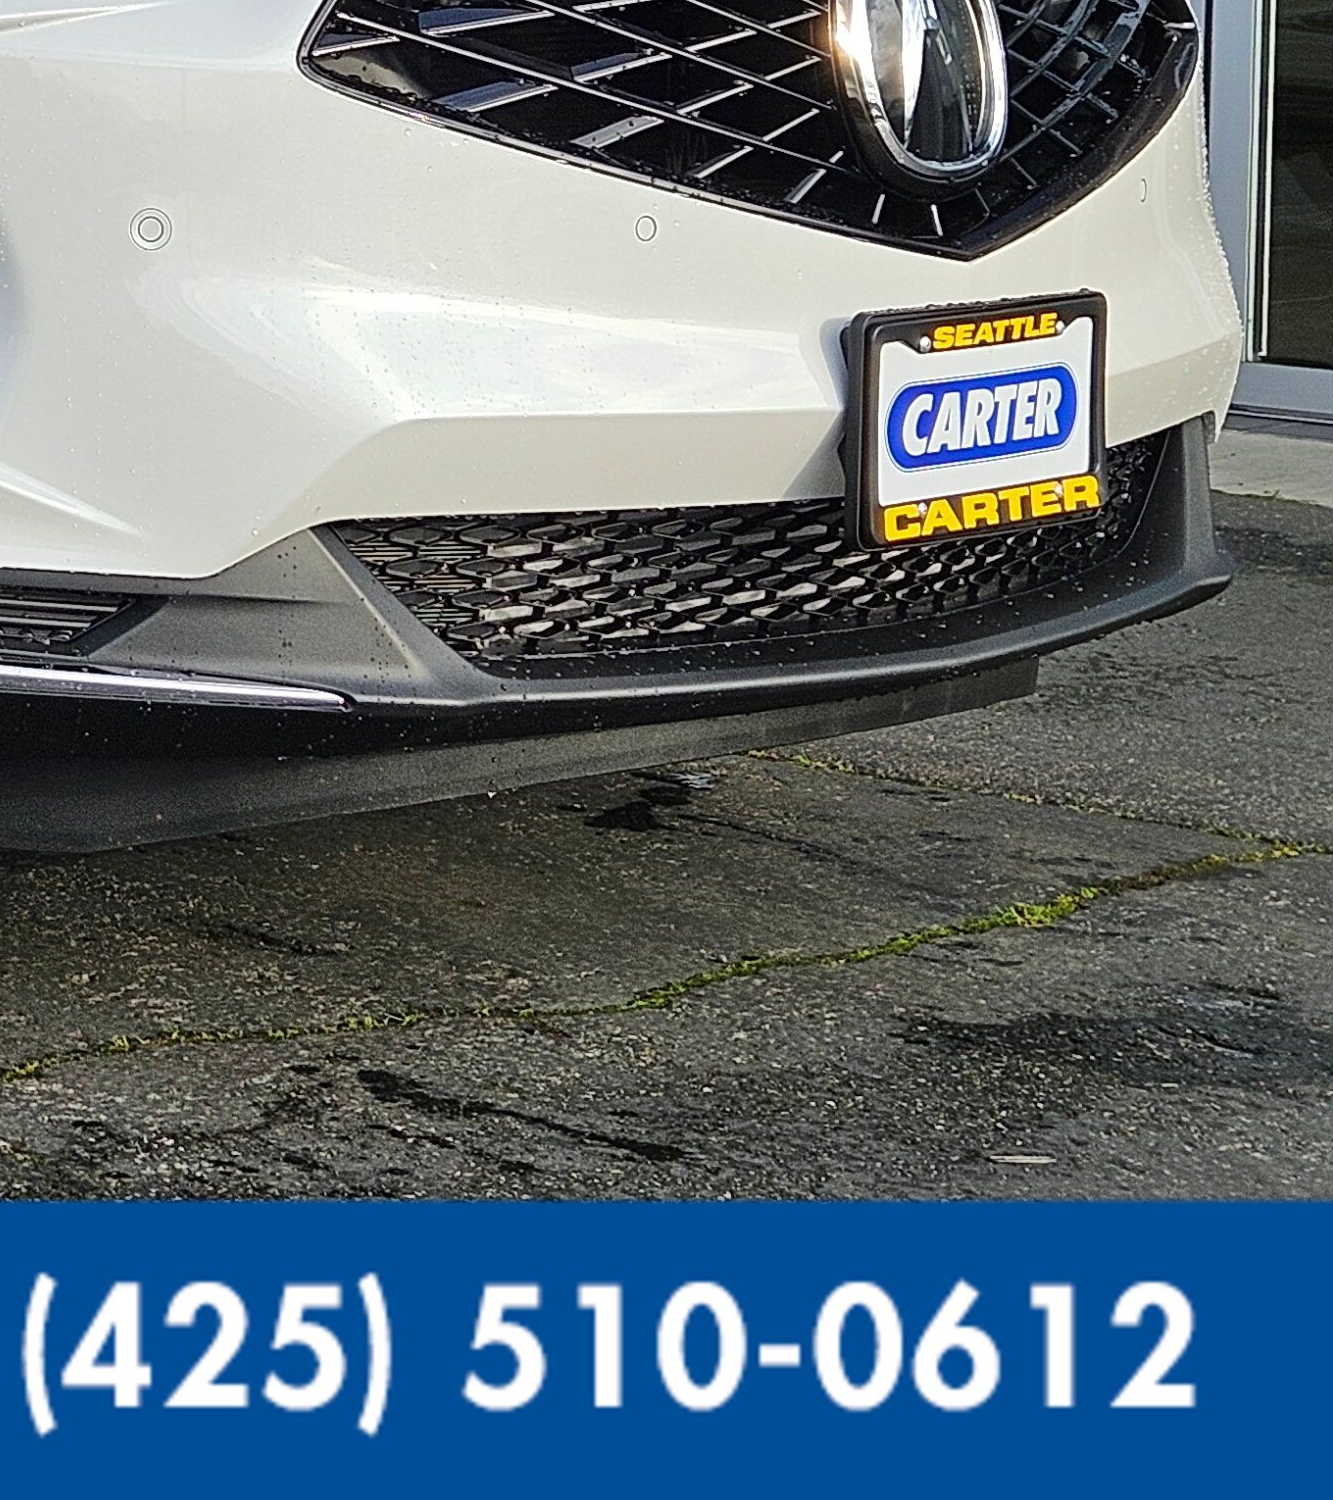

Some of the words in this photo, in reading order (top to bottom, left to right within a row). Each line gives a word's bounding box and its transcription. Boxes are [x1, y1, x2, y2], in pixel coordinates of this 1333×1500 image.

[933, 312, 1058, 350] SEATTLE
[901, 377, 1062, 457] CARTER
[884, 474, 1101, 542] CARTER
